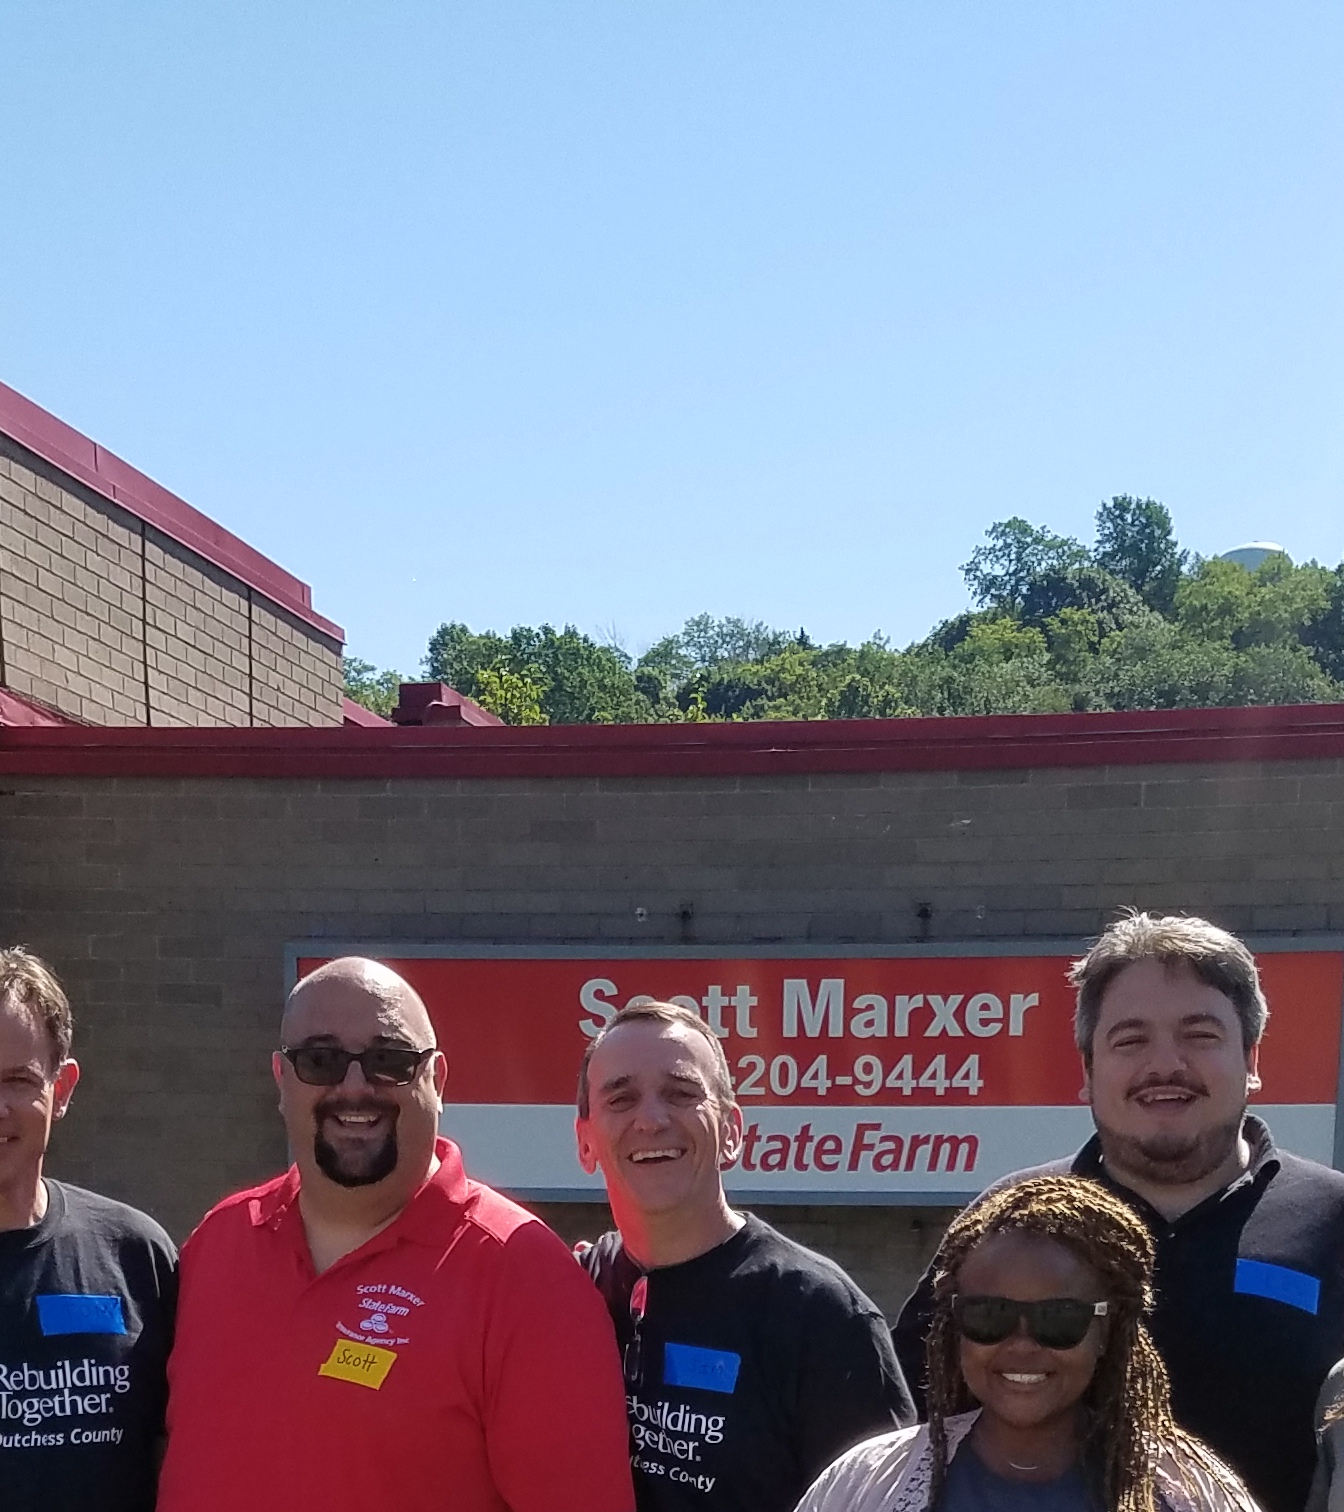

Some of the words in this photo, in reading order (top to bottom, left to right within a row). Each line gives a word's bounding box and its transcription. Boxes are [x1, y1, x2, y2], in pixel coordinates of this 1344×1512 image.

[578, 977, 758, 1039] Stt
[782, 977, 1040, 1039] Marxer
[721, 1122, 980, 1174] tateFarm
[356, 1284, 387, 1295] Scott
[388, 1285, 426, 1307] Marxer
[337, 1349, 378, 1373] Scott
[70, 1426, 124, 1445] County
